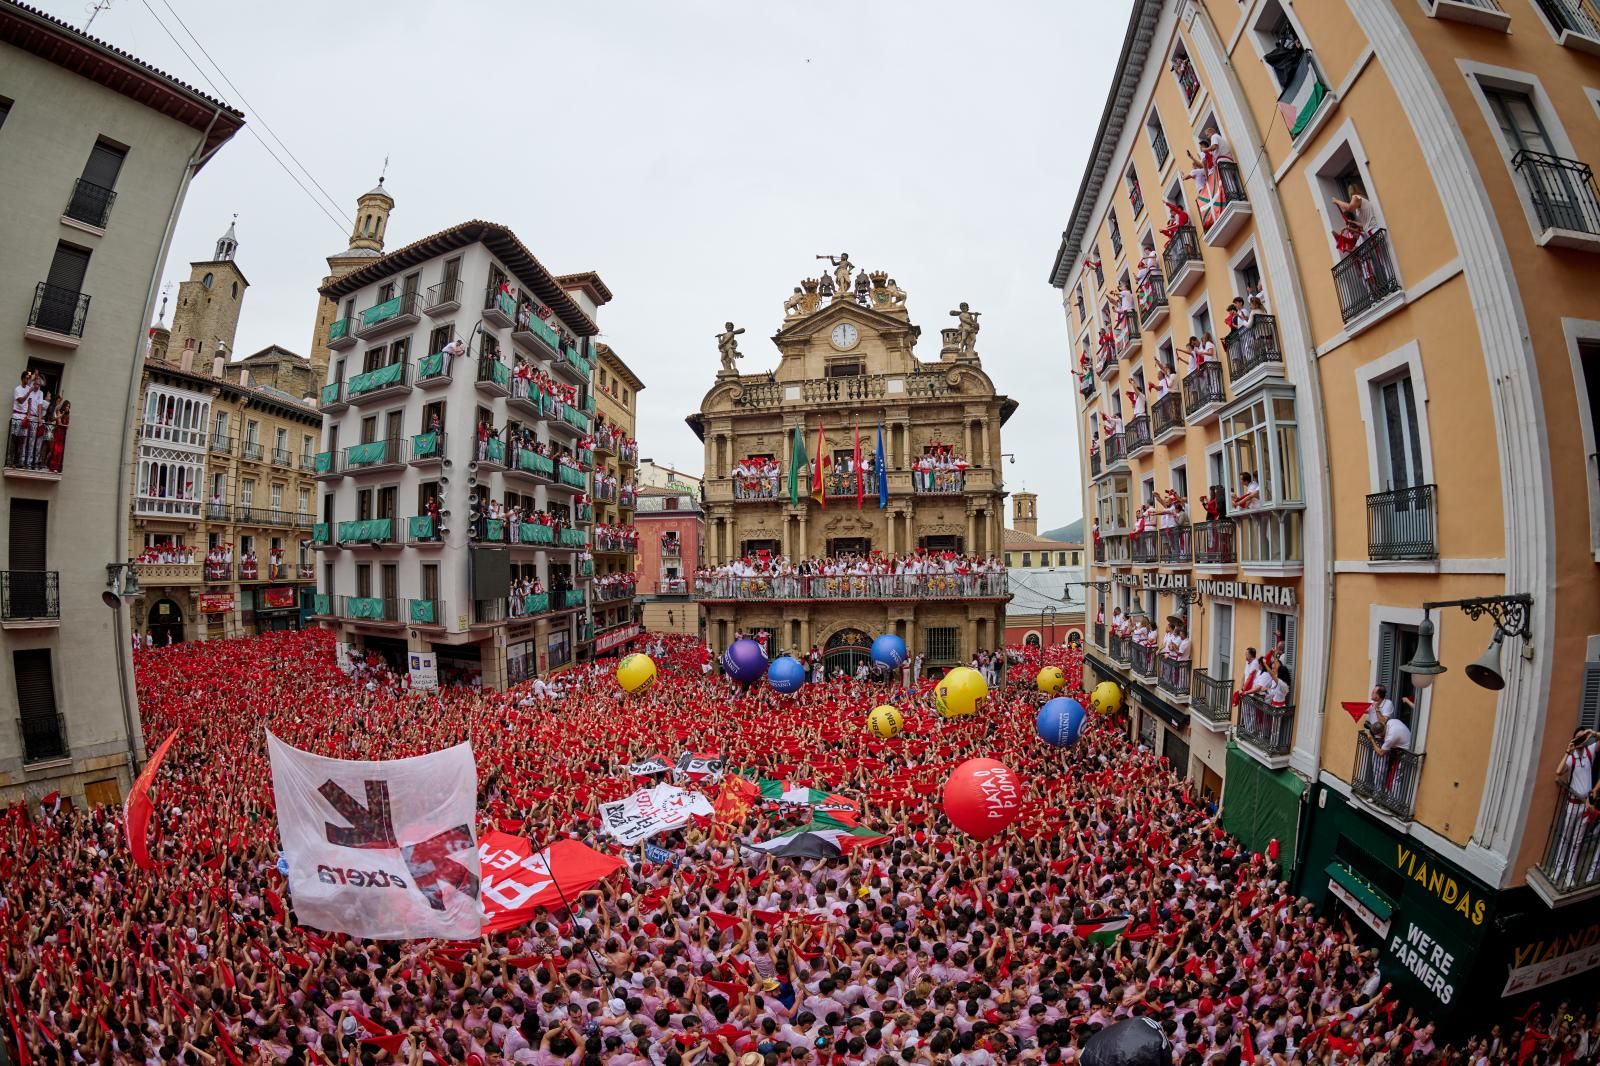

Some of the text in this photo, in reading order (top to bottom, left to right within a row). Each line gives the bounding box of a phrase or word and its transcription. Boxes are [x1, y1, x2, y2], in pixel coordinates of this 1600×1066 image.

[1113, 573, 1292, 606] GENCIA ELIZARI INMOBILIARIA
[980, 777, 1004, 818] PLATA
[990, 768, 1018, 808] PLOMO
[1397, 844, 1486, 926] VIANDAS
[1389, 935, 1454, 1005] FARMERS
[1407, 922, 1454, 976] WE'RE
